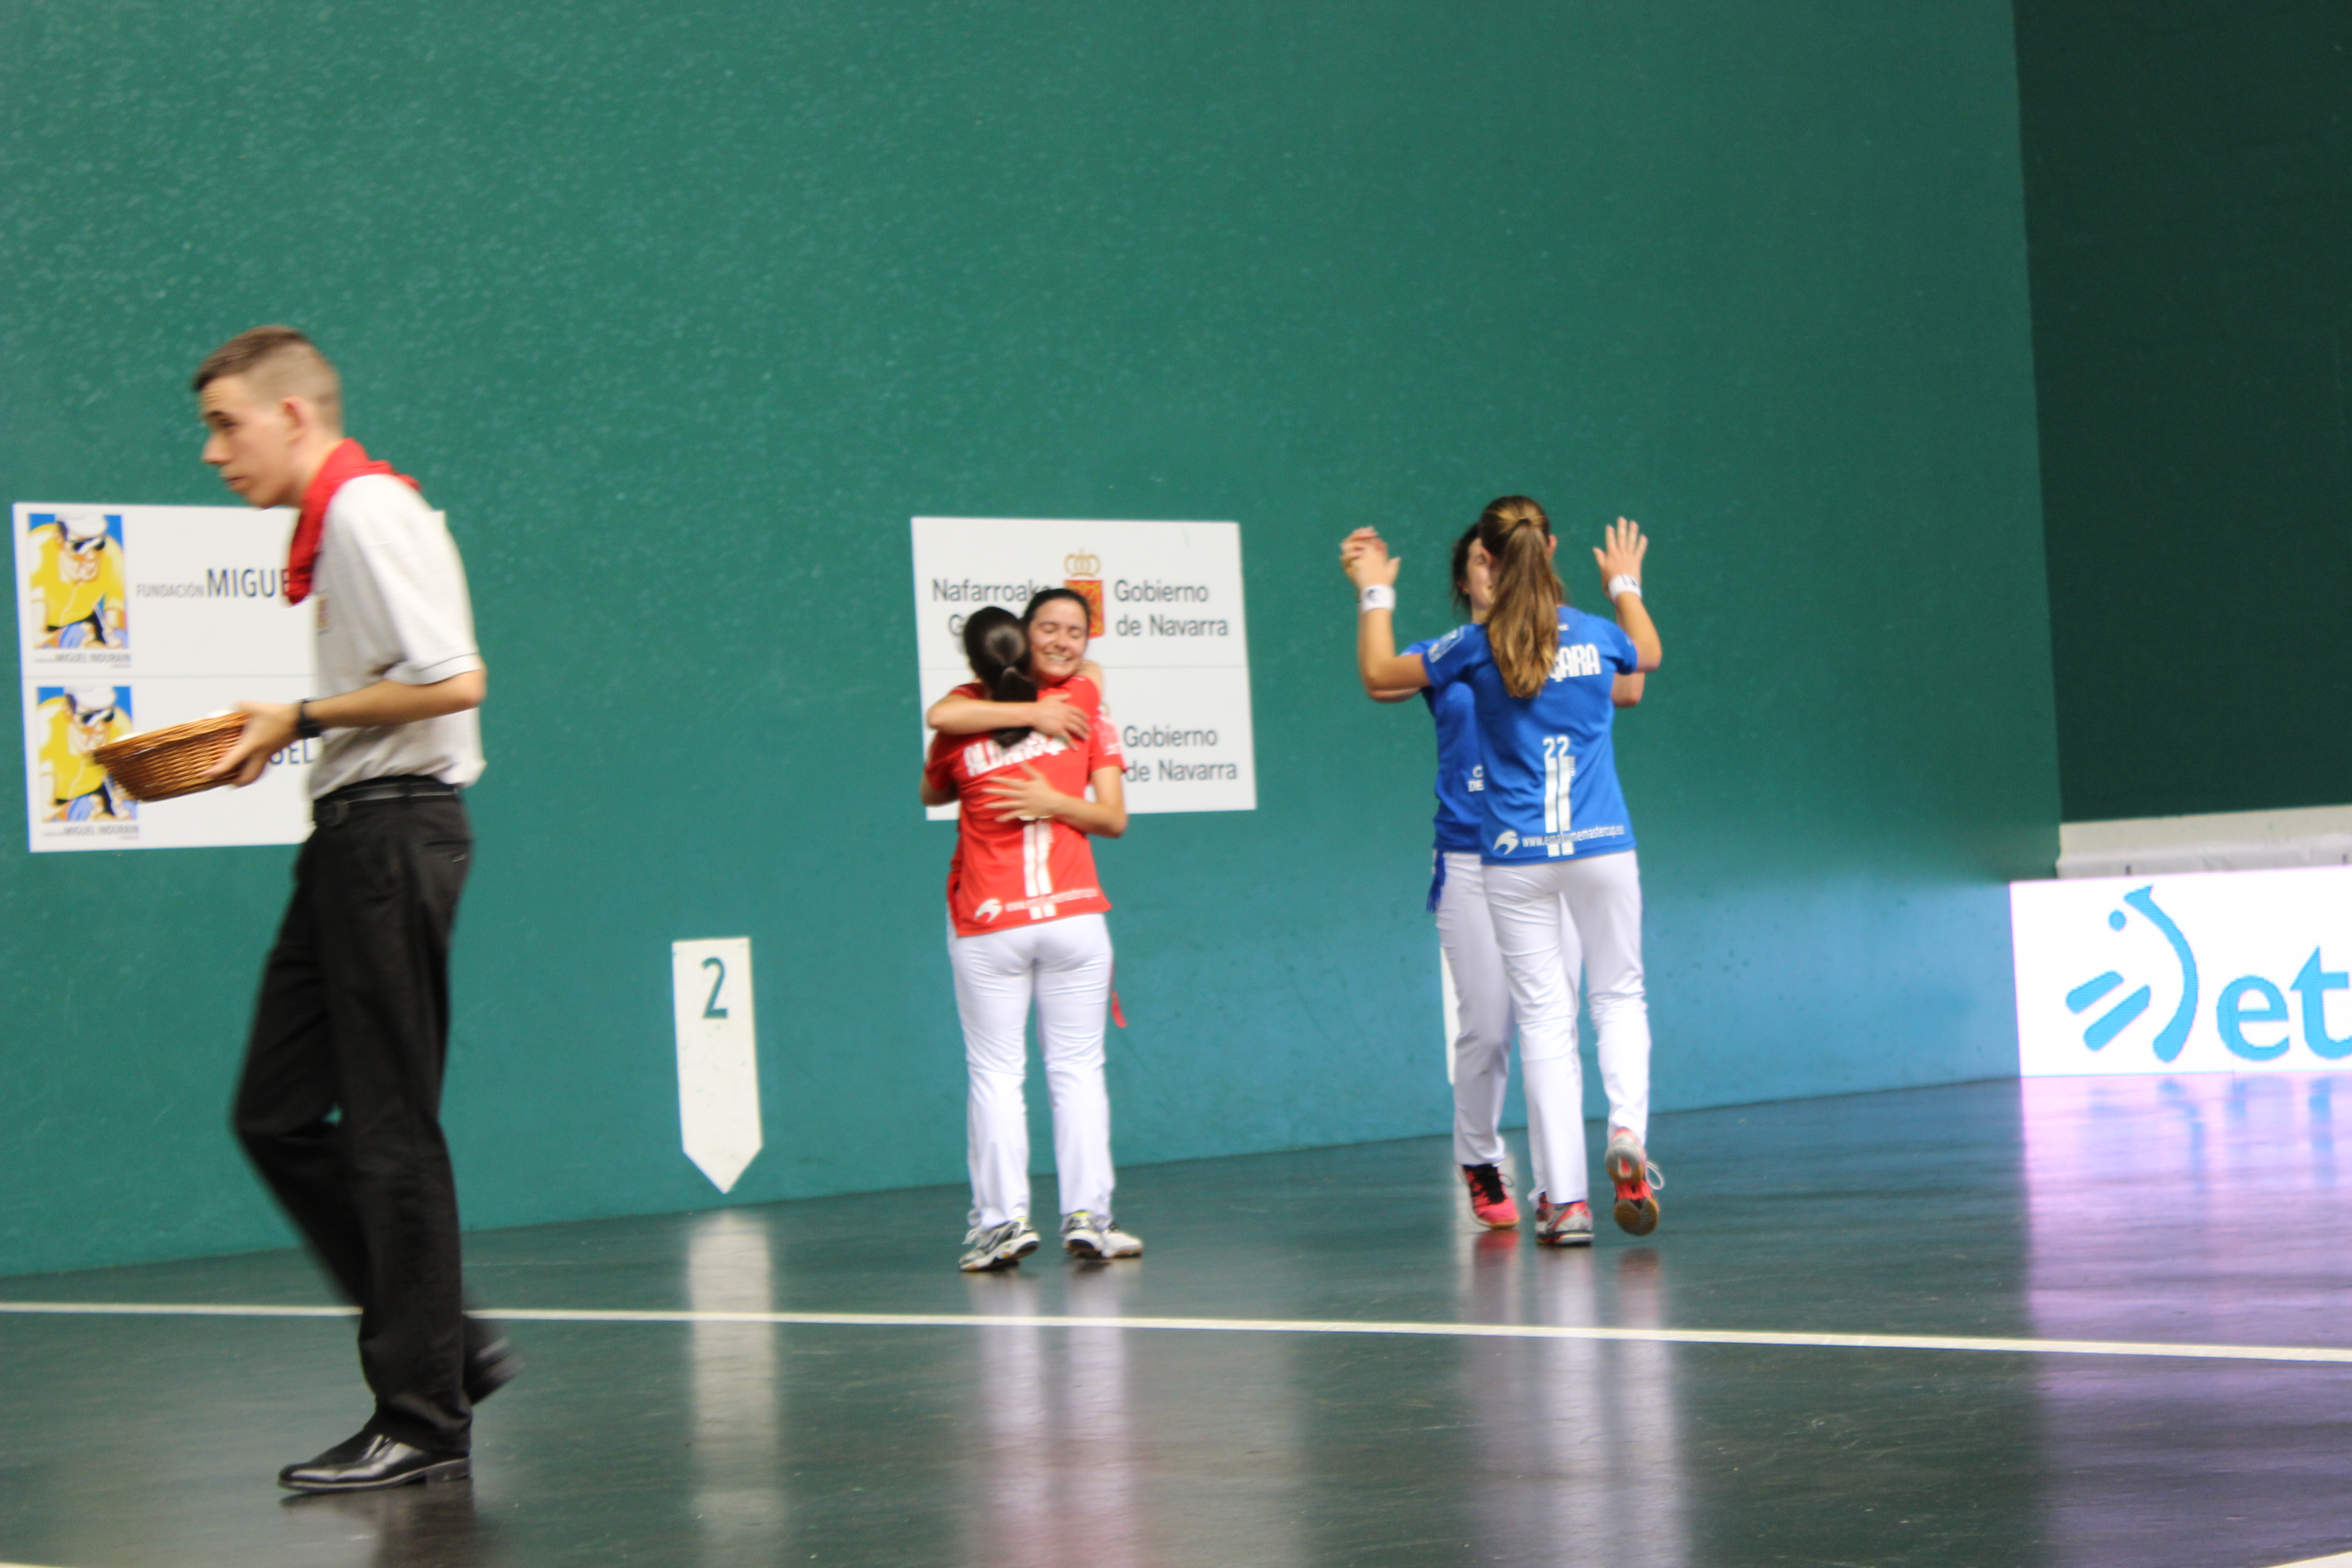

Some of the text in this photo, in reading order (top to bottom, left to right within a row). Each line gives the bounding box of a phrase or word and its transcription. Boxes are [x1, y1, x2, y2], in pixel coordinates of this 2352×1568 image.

[207, 568, 290, 597] MIGUE
[1115, 579, 1209, 602] Gobierno
[1116, 614, 1228, 636] de Navarra
[1123, 725, 1218, 747] Gobierno
[1125, 760, 1237, 781] de Navarra
[701, 957, 729, 1019] 2
